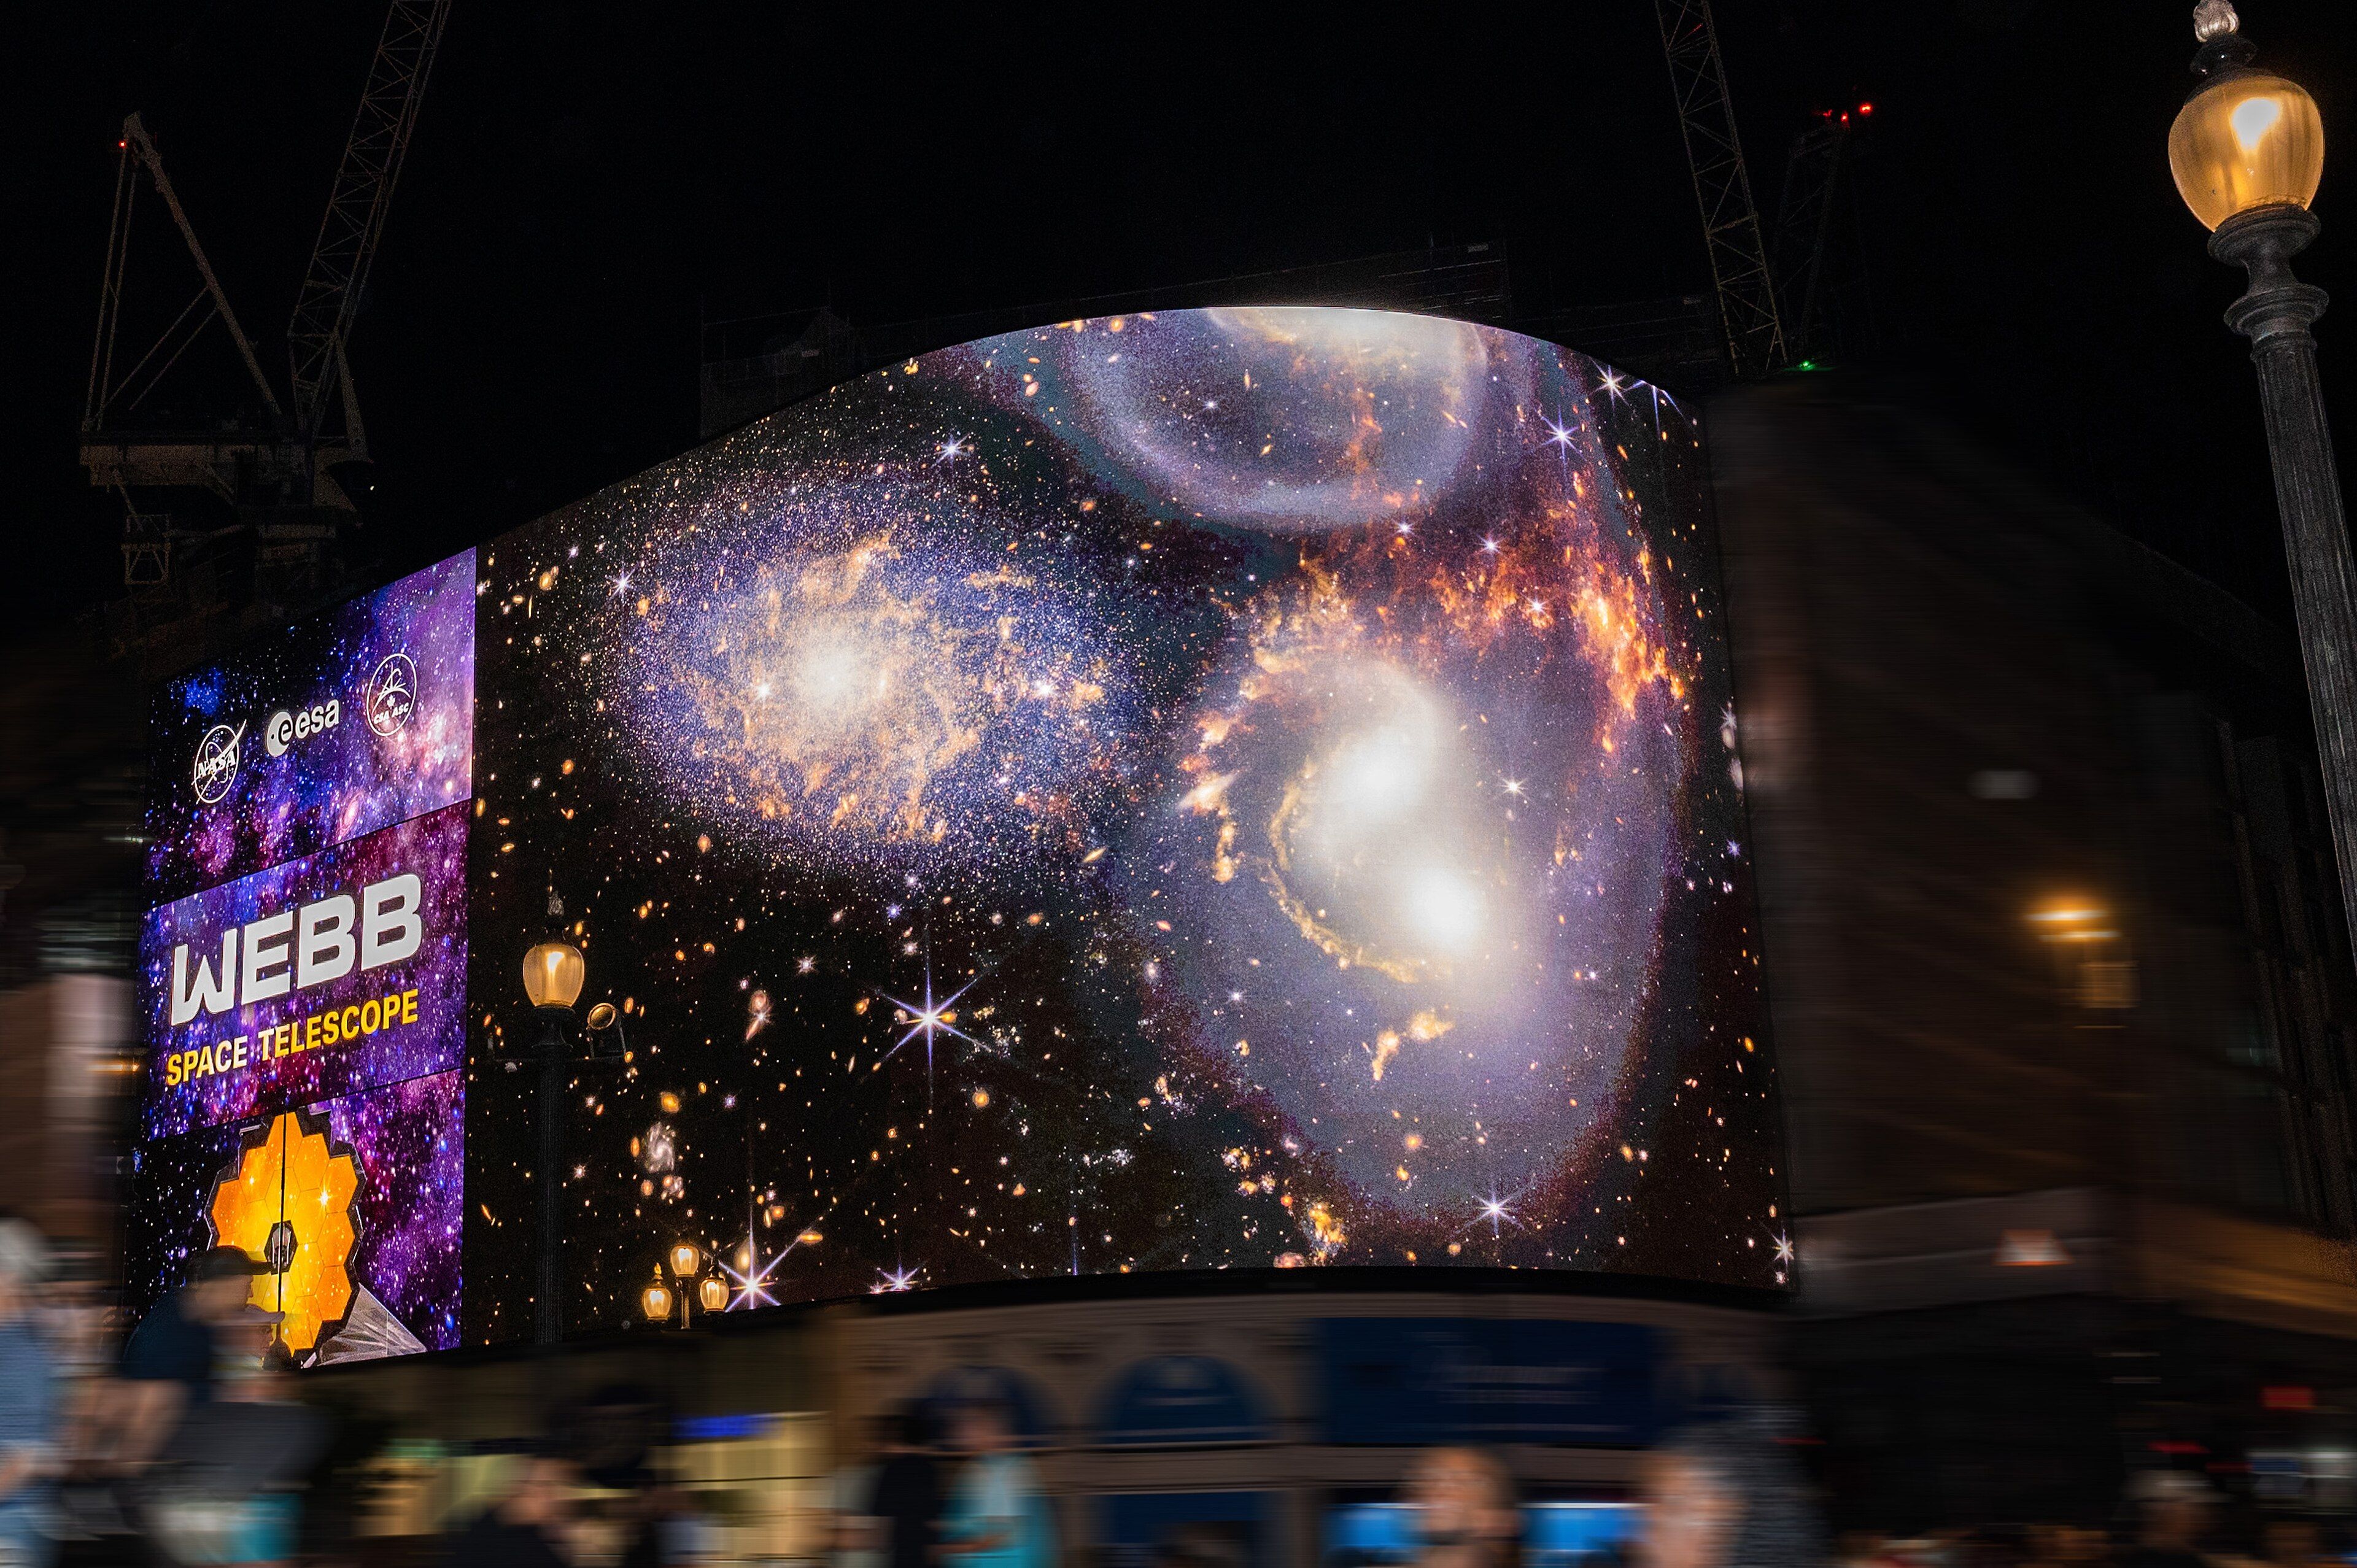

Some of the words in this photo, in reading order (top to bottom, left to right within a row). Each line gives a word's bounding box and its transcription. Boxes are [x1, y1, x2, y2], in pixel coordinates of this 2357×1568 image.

[198, 750, 236, 777] NASA
[171, 875, 422, 1025] WEBB
[166, 1036, 248, 1086] SPACE
[258, 989, 419, 1060] TELESCOPE
